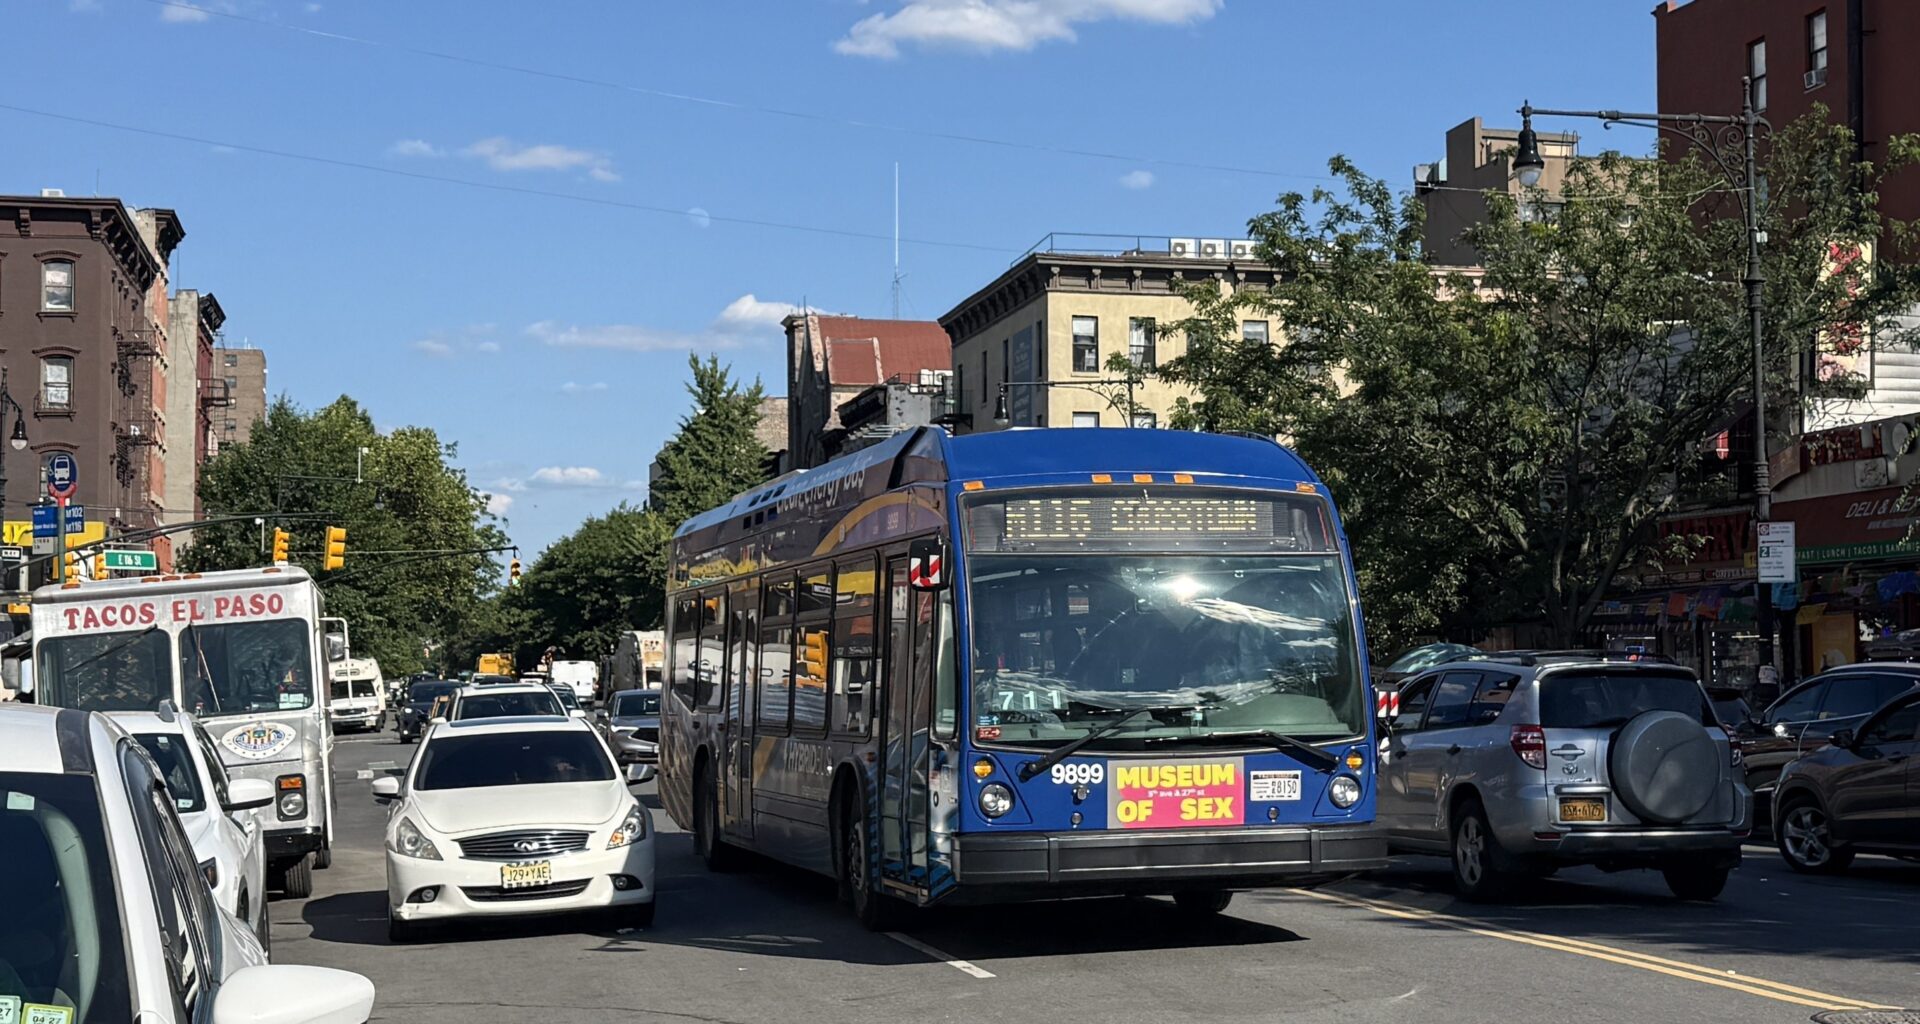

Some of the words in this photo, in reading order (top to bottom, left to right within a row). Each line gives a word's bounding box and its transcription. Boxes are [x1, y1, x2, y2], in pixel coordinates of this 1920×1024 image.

[65, 506, 83, 518] M102
[1845, 500, 1878, 518] DELI
[65, 521, 82, 532] M116
[118, 554, 123, 565] E
[1853, 544, 1877, 557] TACOS
[64, 603, 155, 630] TACOS
[172, 599, 205, 622] EL
[214, 593, 284, 618] PASO
[1051, 763, 1104, 784] 9899
[1116, 763, 1235, 790] MUSEUM
[1116, 799, 1154, 823] OF
[1180, 796, 1234, 820] SEX
